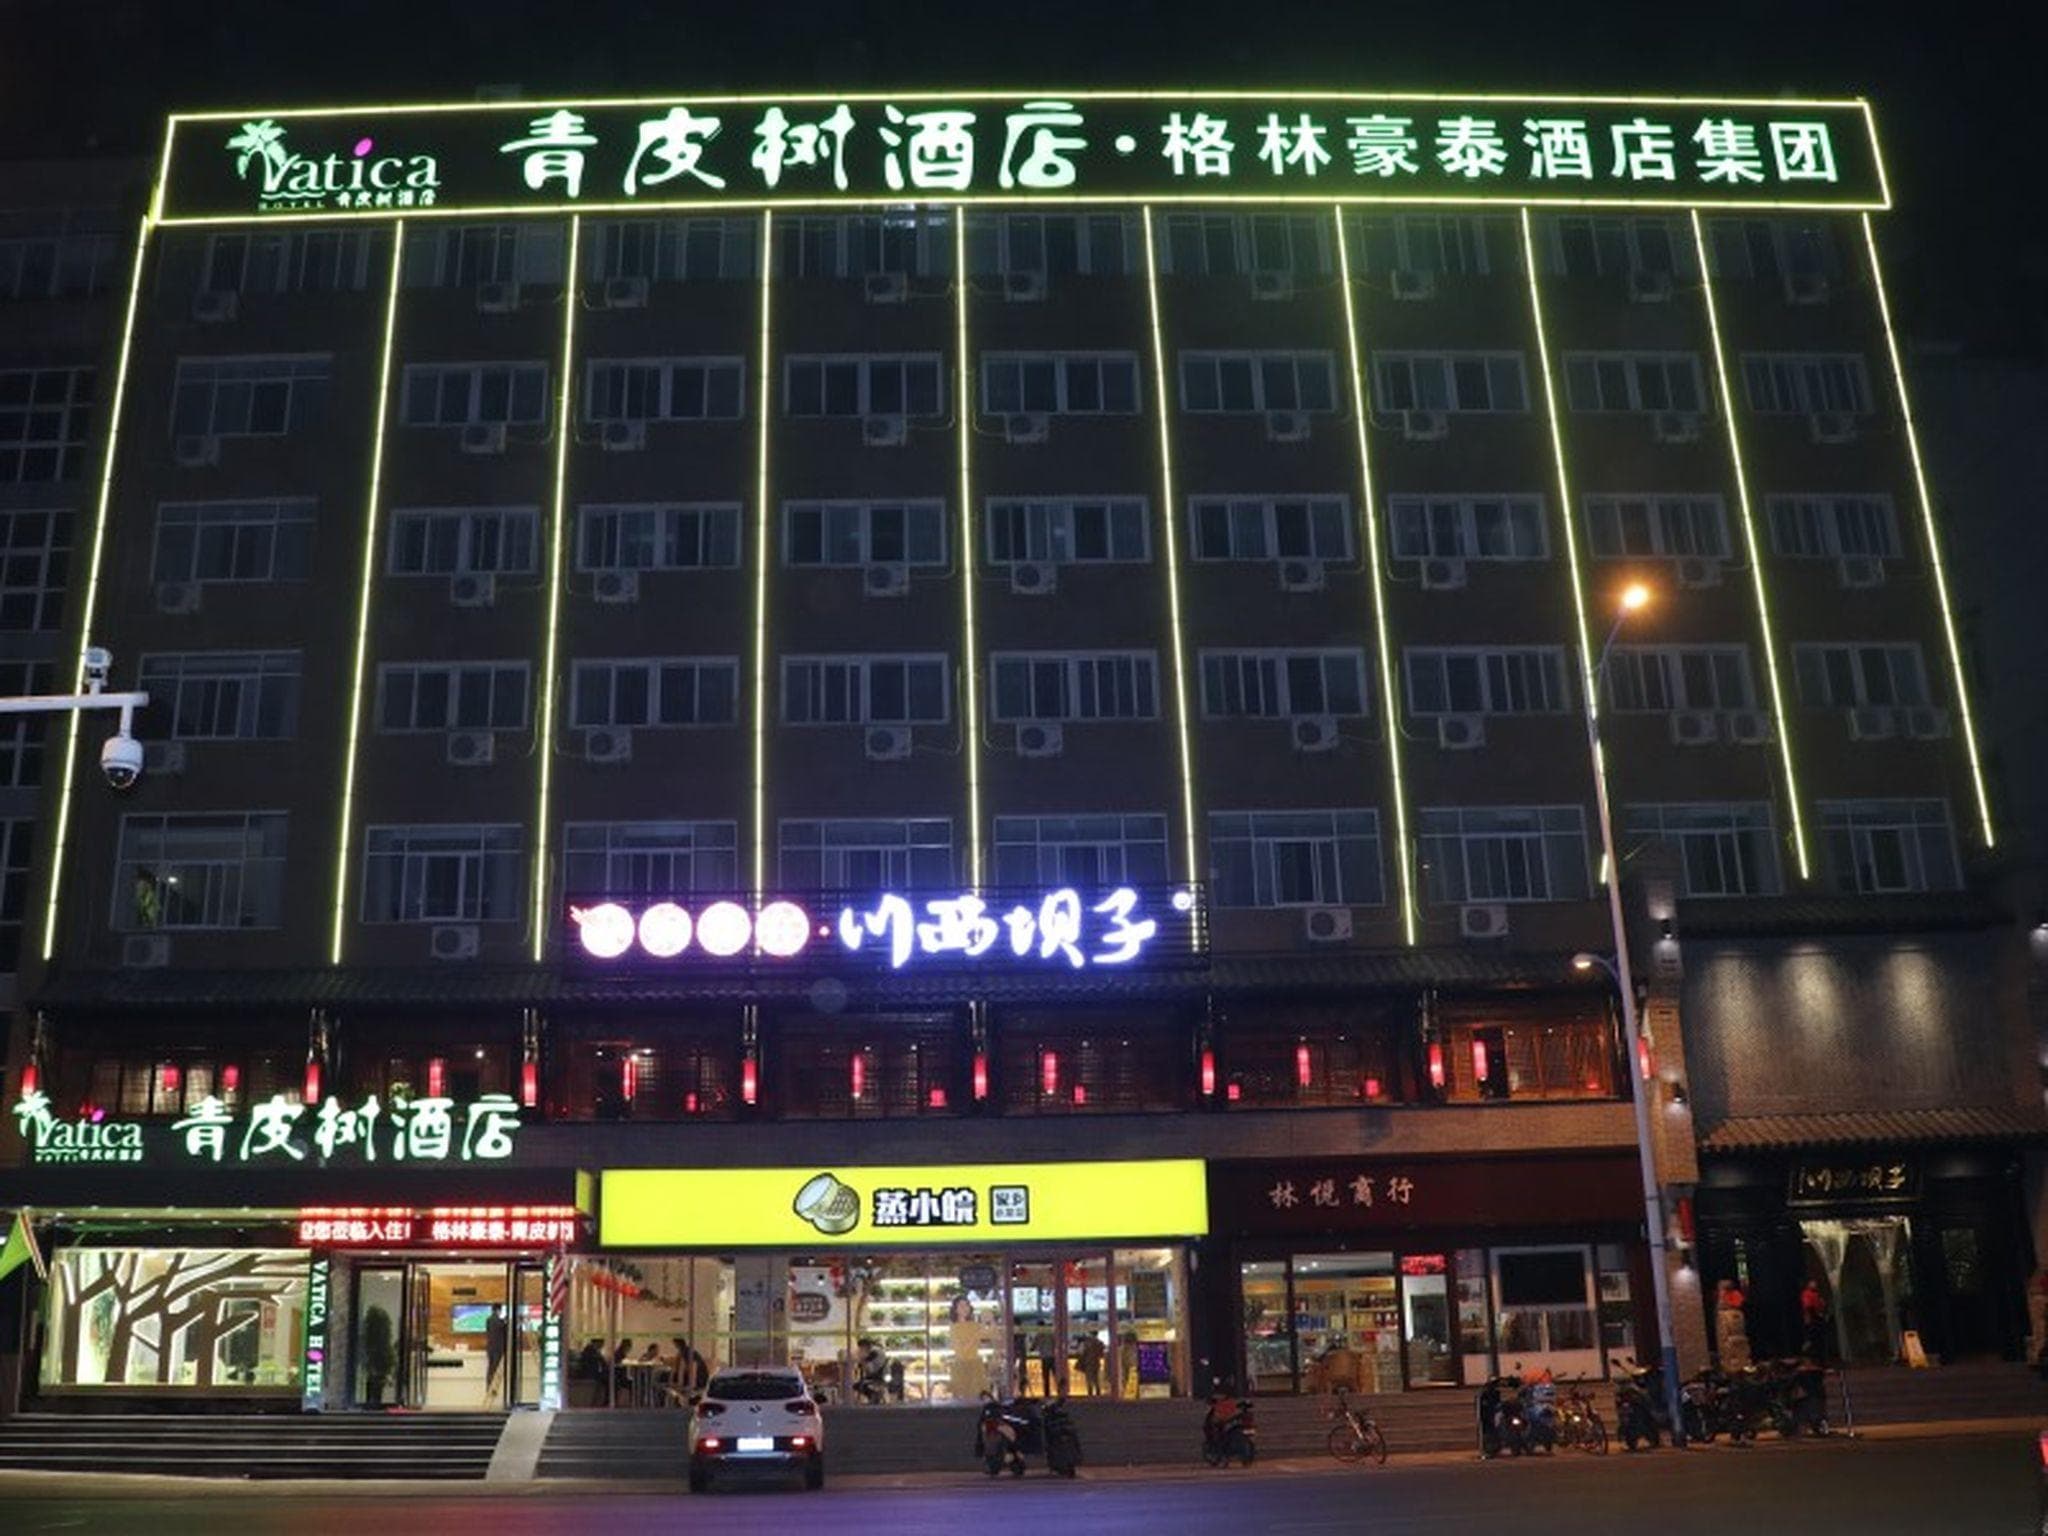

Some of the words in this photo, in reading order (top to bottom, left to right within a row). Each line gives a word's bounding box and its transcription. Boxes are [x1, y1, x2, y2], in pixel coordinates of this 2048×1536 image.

[262, 137, 441, 193] Vatica
[838, 888, 1158, 969] 川西坝子
[36, 1109, 144, 1148] Vatica
[171, 1093, 522, 1162] 青皮树酒店
[308, 1260, 329, 1327] VATICA
